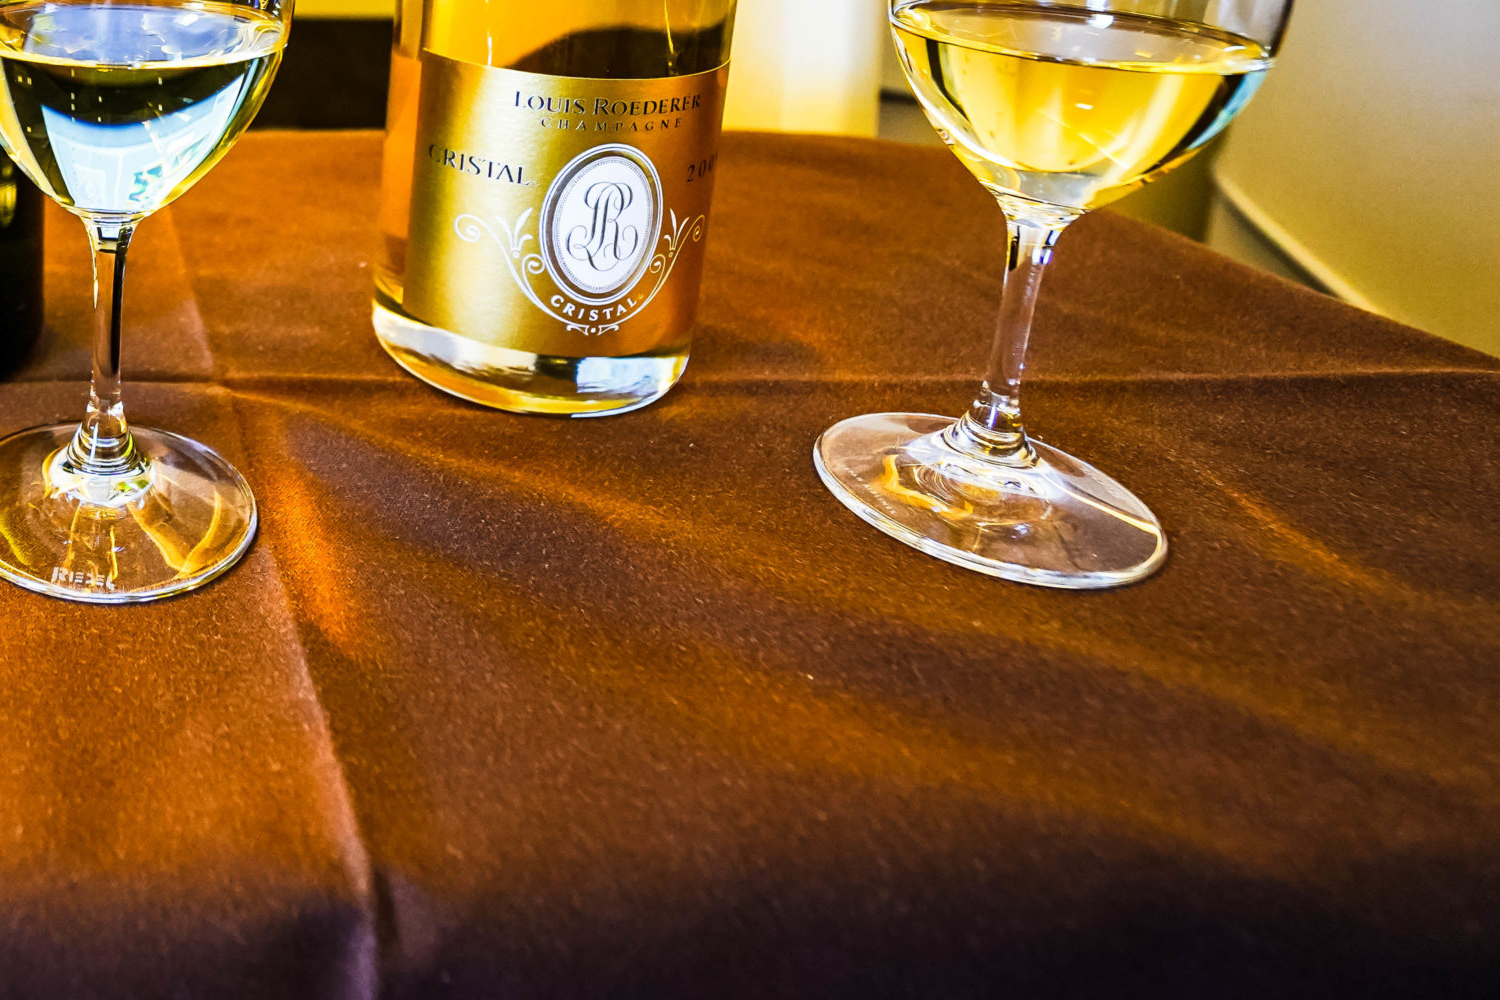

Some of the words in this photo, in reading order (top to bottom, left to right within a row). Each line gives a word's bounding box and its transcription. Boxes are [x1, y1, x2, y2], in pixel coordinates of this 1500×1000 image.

[514, 91, 586, 114] LOUIS
[592, 94, 701, 116] ROEDERER
[541, 117, 683, 132] CHAMPAGNE
[429, 144, 531, 186] CRISTAL
[550, 294, 638, 322] CRISTAL
